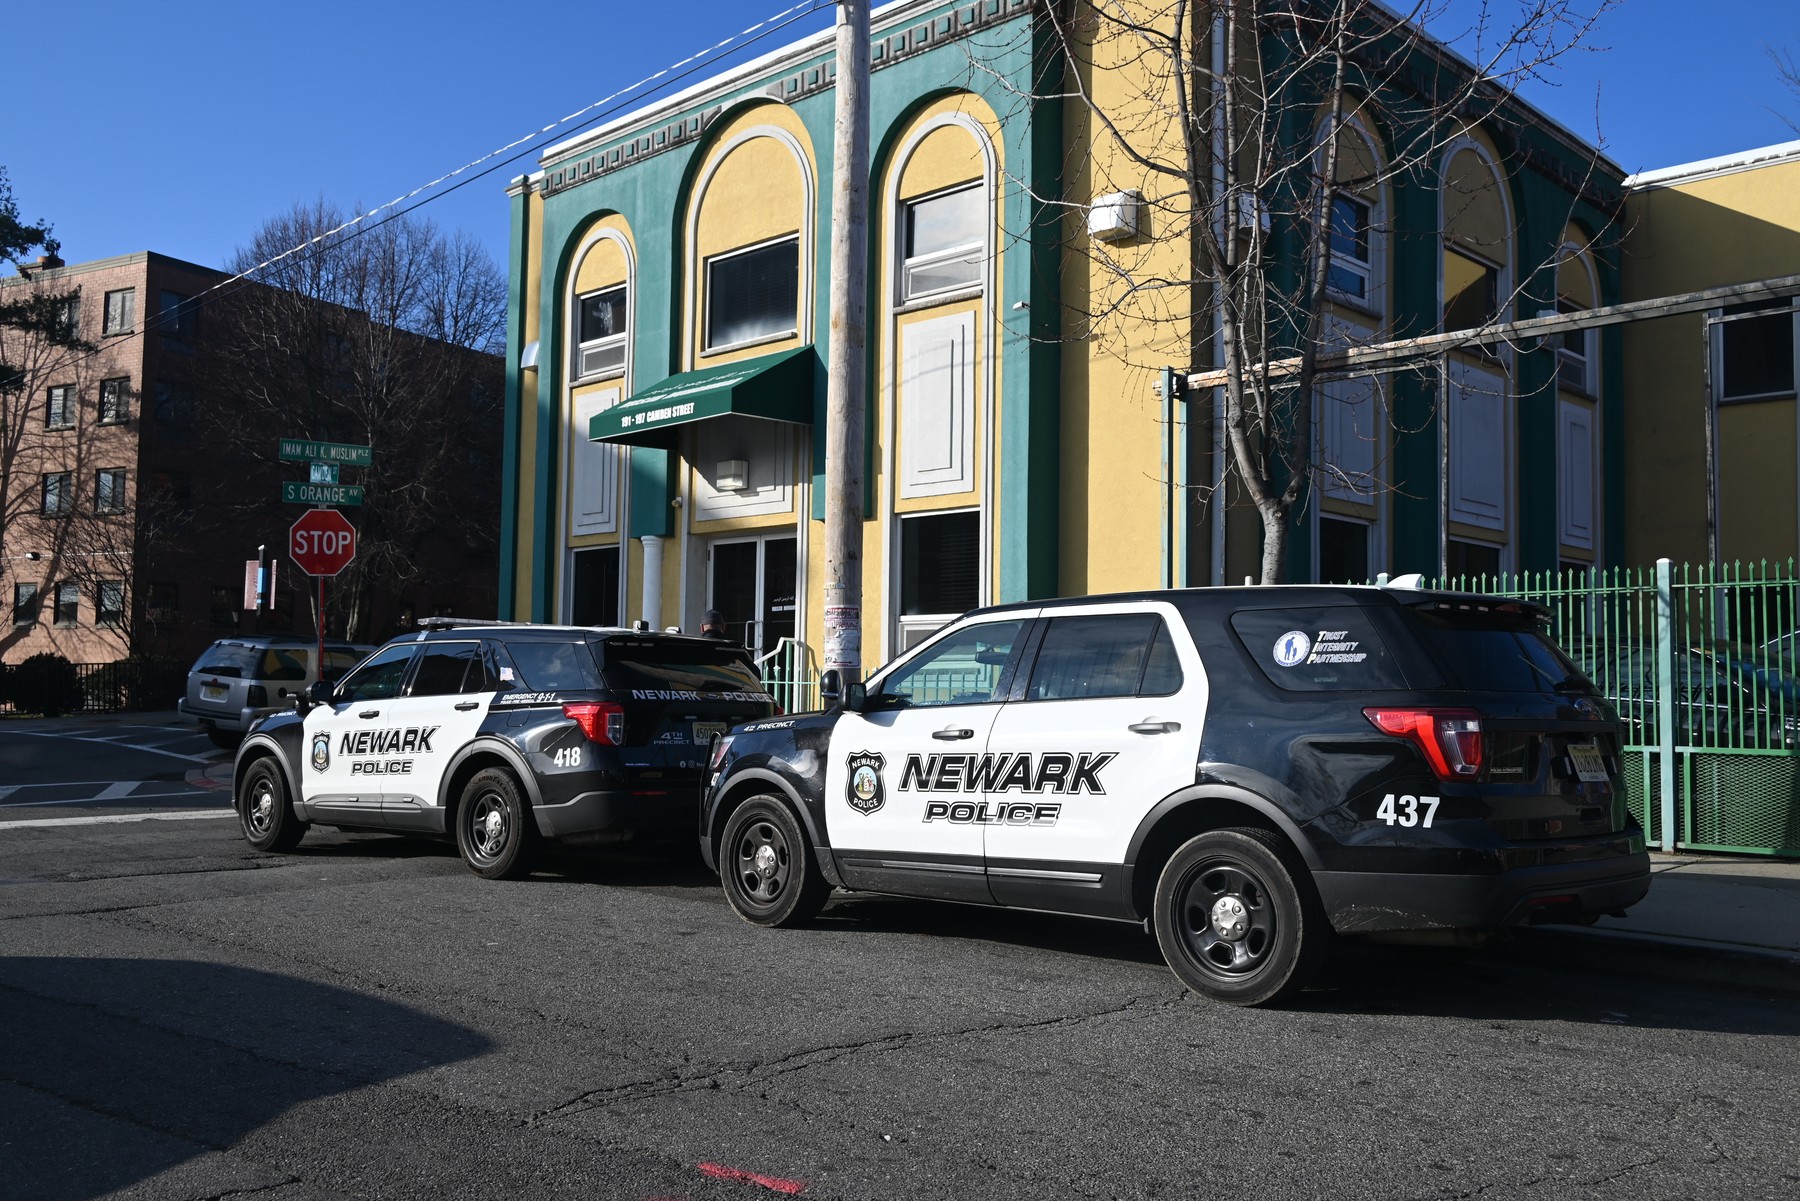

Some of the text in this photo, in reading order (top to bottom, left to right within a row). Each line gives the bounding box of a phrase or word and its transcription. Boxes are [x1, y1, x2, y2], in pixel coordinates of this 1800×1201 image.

[621, 416, 632, 428] 191
[646, 406, 671, 422] CAMDEN
[672, 402, 694, 417] STREET
[282, 443, 301, 456] IMAM
[305, 445, 316, 457] ALI
[320, 446, 327, 458] K.
[330, 447, 356, 460] MUSLIM
[288, 485, 294, 499] S
[300, 486, 345, 502] ORANGE
[295, 530, 351, 554] STOP
[1317, 630, 1348, 641] TRUST
[1312, 642, 1359, 652] INTEGRITY
[1306, 653, 1367, 664] PARTNERSHIP
[632, 690, 774, 702] NEWARK POLICE
[757, 720, 795, 730] PRECINCT
[338, 725, 441, 756] NEWARK
[554, 746, 581, 767] 418
[852, 758, 880, 769] NEWARK
[350, 759, 414, 776] POLICE
[898, 752, 1120, 795] NEWARK
[853, 797, 878, 808] POLICE
[1376, 794, 1440, 828] 437
[922, 801, 1062, 827] POLICE
